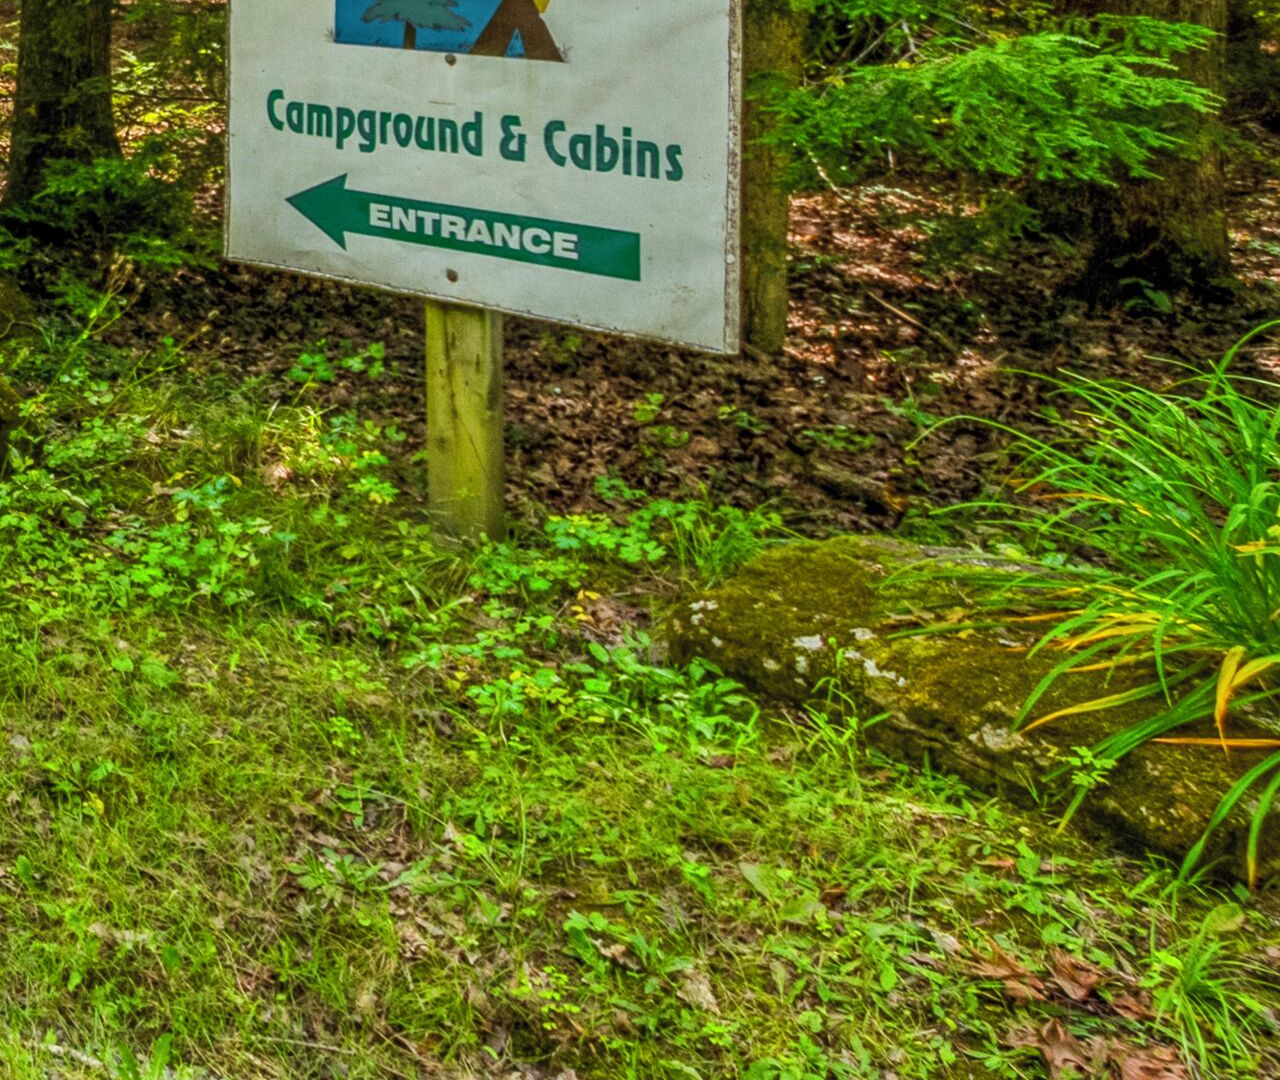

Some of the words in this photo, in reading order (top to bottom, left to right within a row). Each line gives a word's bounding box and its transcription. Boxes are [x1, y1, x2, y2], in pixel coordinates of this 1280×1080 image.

[267, 89, 483, 157] Campground
[499, 116, 526, 162] &
[544, 120, 684, 181] Cabins
[369, 202, 579, 260] ENTRANCE
